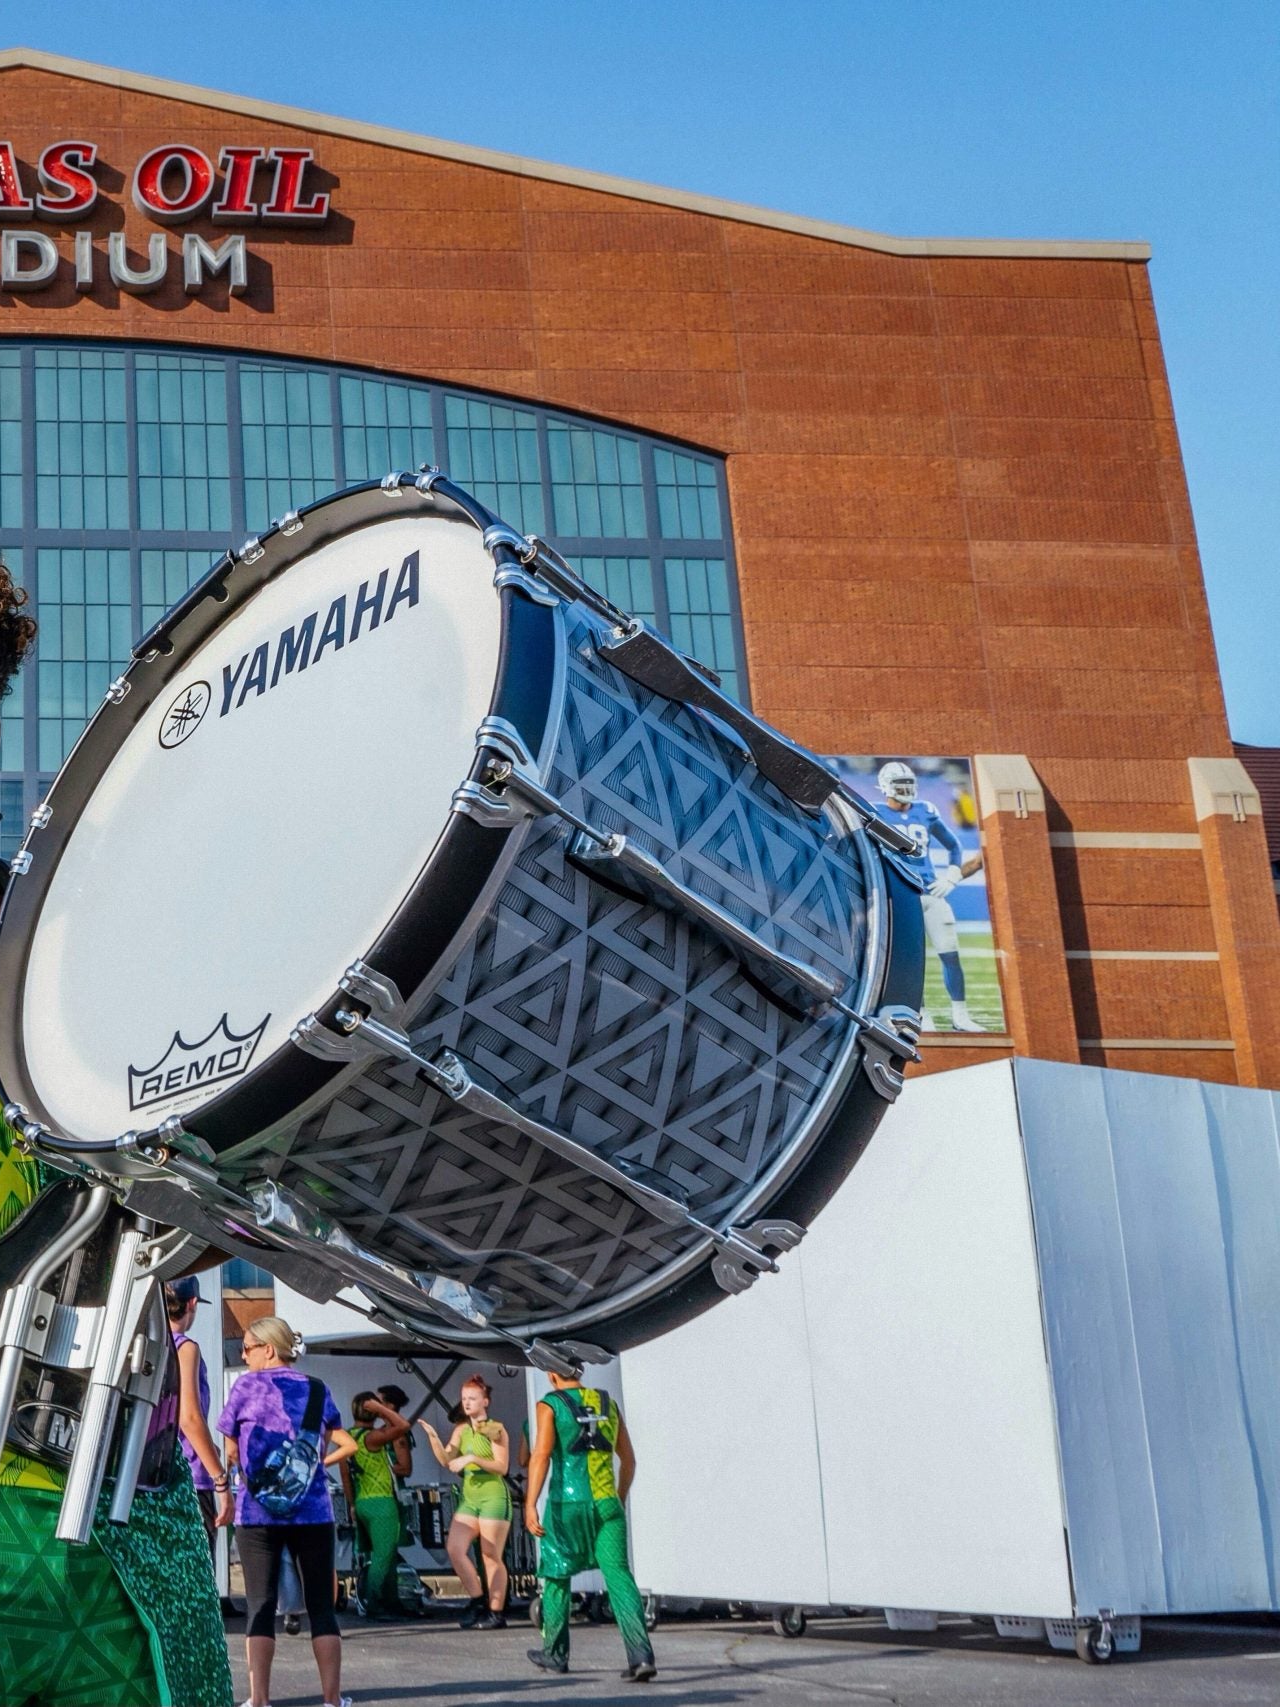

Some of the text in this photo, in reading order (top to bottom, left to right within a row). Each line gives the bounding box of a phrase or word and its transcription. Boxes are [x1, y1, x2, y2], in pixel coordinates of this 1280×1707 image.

[133, 144, 330, 226] OIL
[219, 549, 420, 719] YAMAHA
[139, 1045, 243, 1100] REMO
